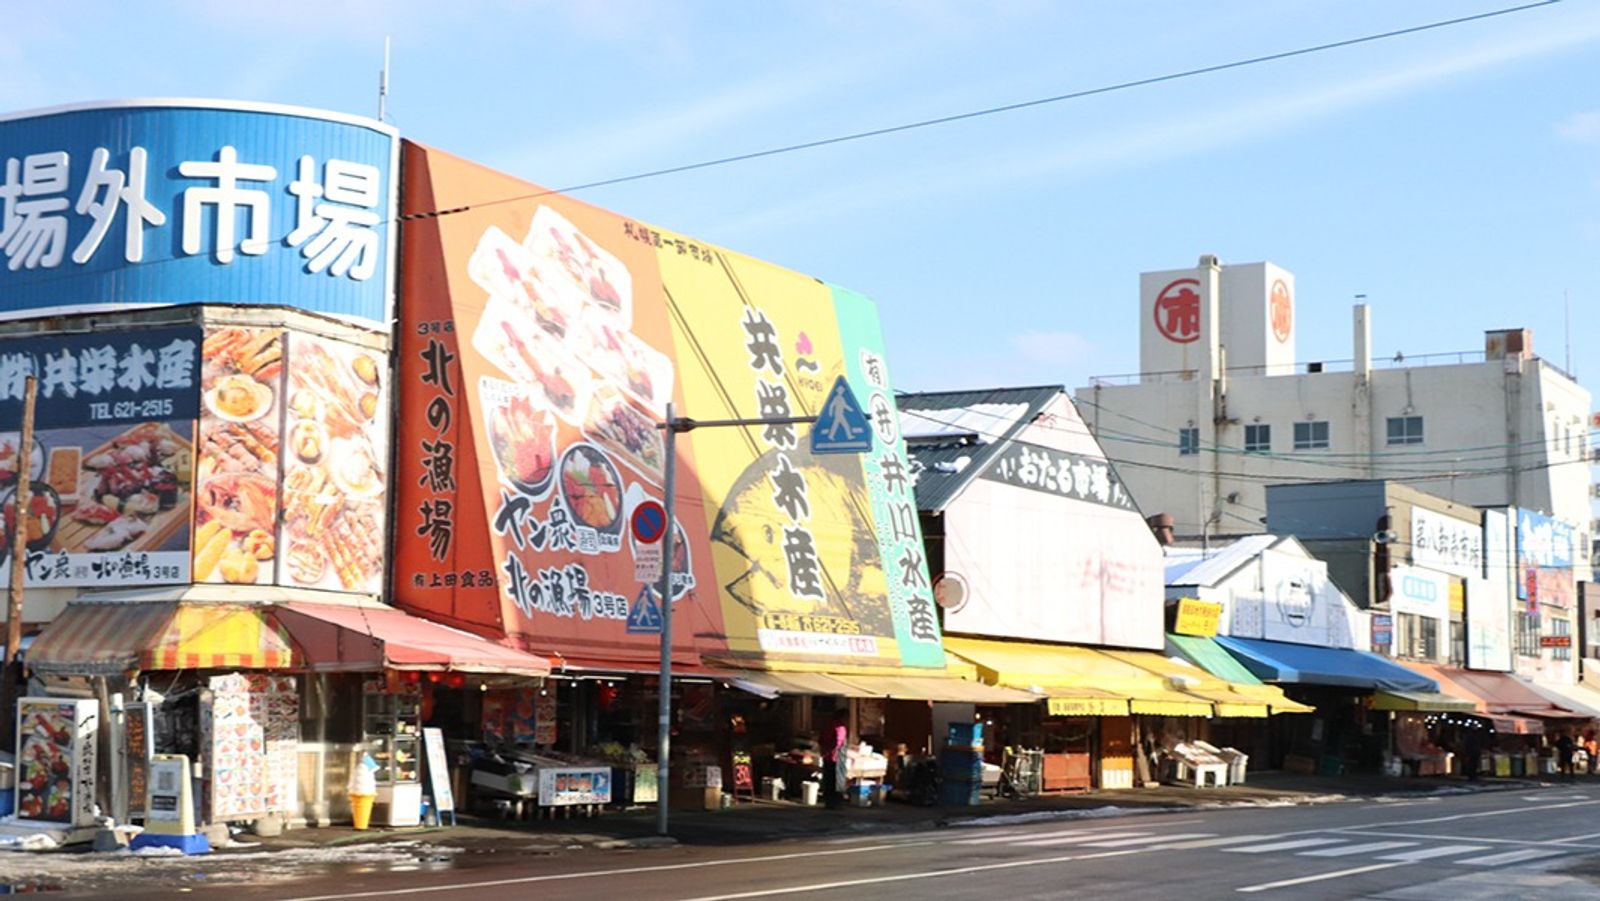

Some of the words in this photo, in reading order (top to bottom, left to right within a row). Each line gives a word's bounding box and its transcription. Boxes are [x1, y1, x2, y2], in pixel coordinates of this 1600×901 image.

[0, 145, 381, 281] 場外市場
[1161, 288, 1200, 337] 市
[90, 403, 113, 420] TEL
[113, 399, 174, 418] 621-2515
[416, 338, 456, 561] 北の漁場
[1017, 446, 1110, 504] おたる市場
[505, 553, 593, 621] 北の漁場
[594, 594, 629, 616] 3号店
